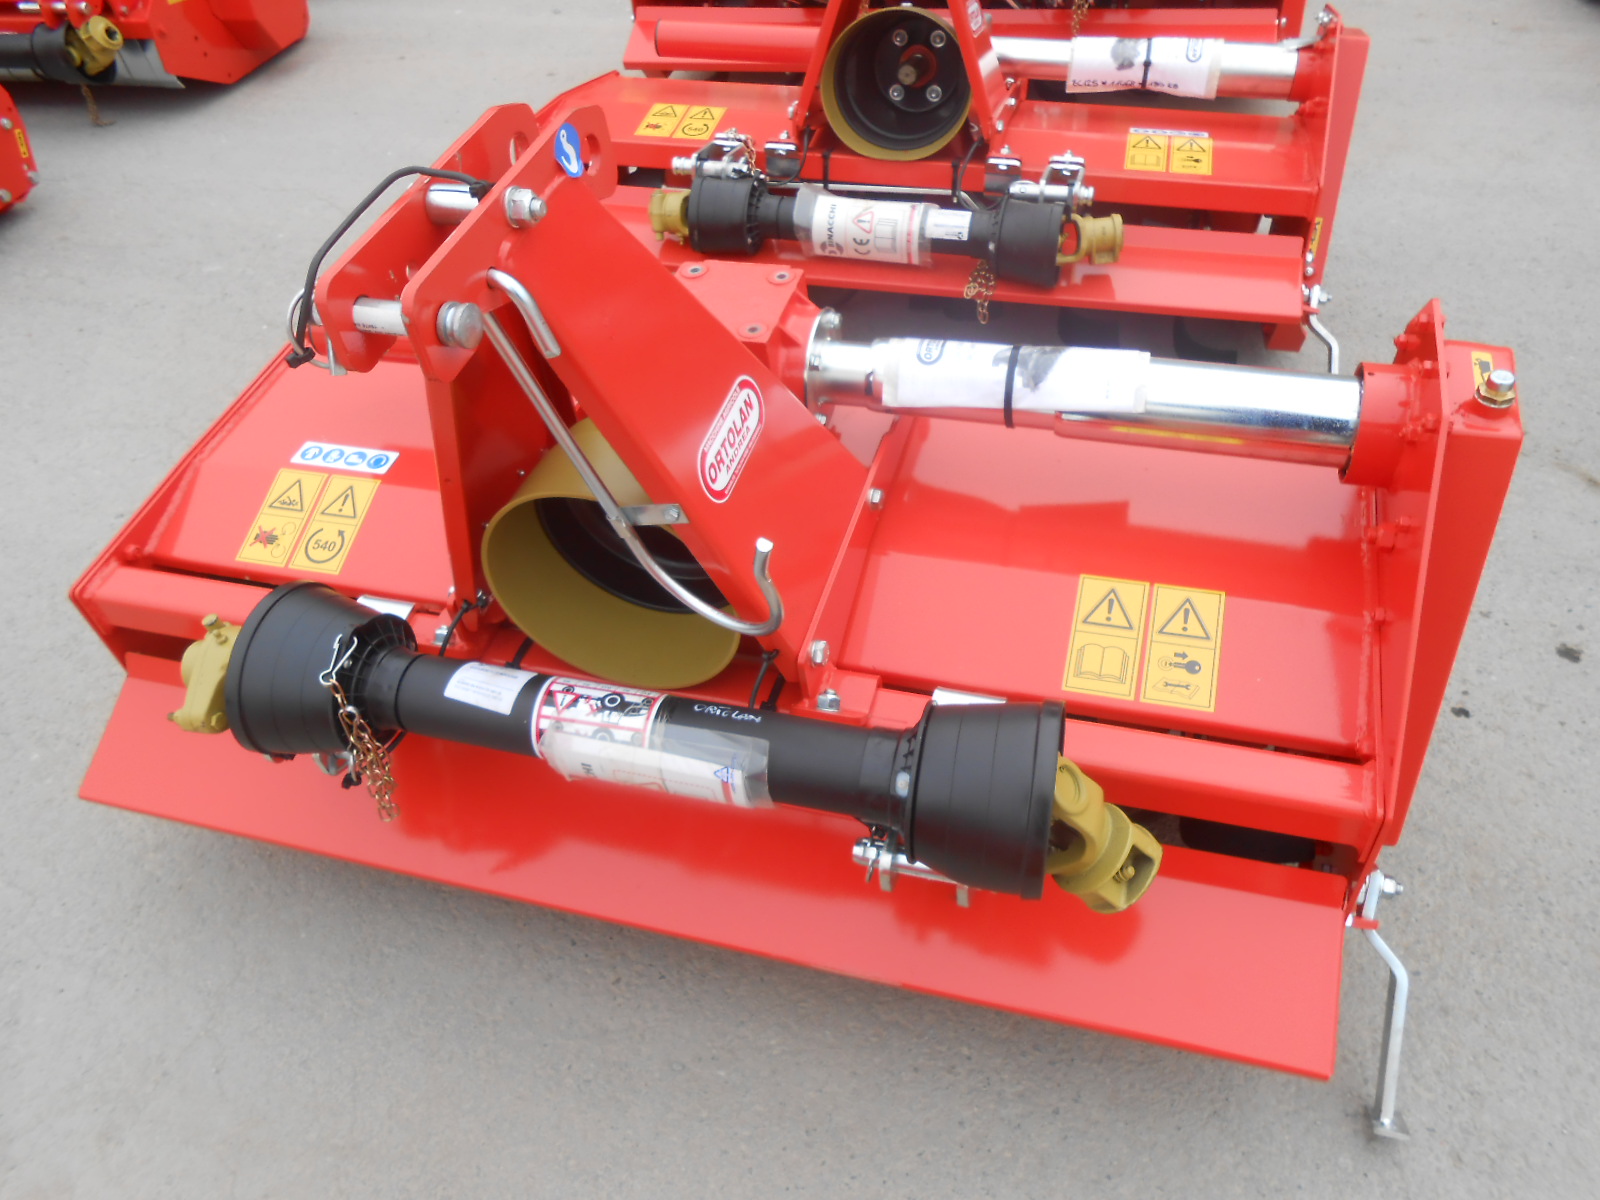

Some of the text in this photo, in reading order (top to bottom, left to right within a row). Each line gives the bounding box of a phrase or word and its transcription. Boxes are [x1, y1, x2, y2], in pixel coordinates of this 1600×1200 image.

[708, 393, 754, 485] ORTOLAN
[726, 425, 751, 475] ANDREA
[312, 539, 337, 552] 540
